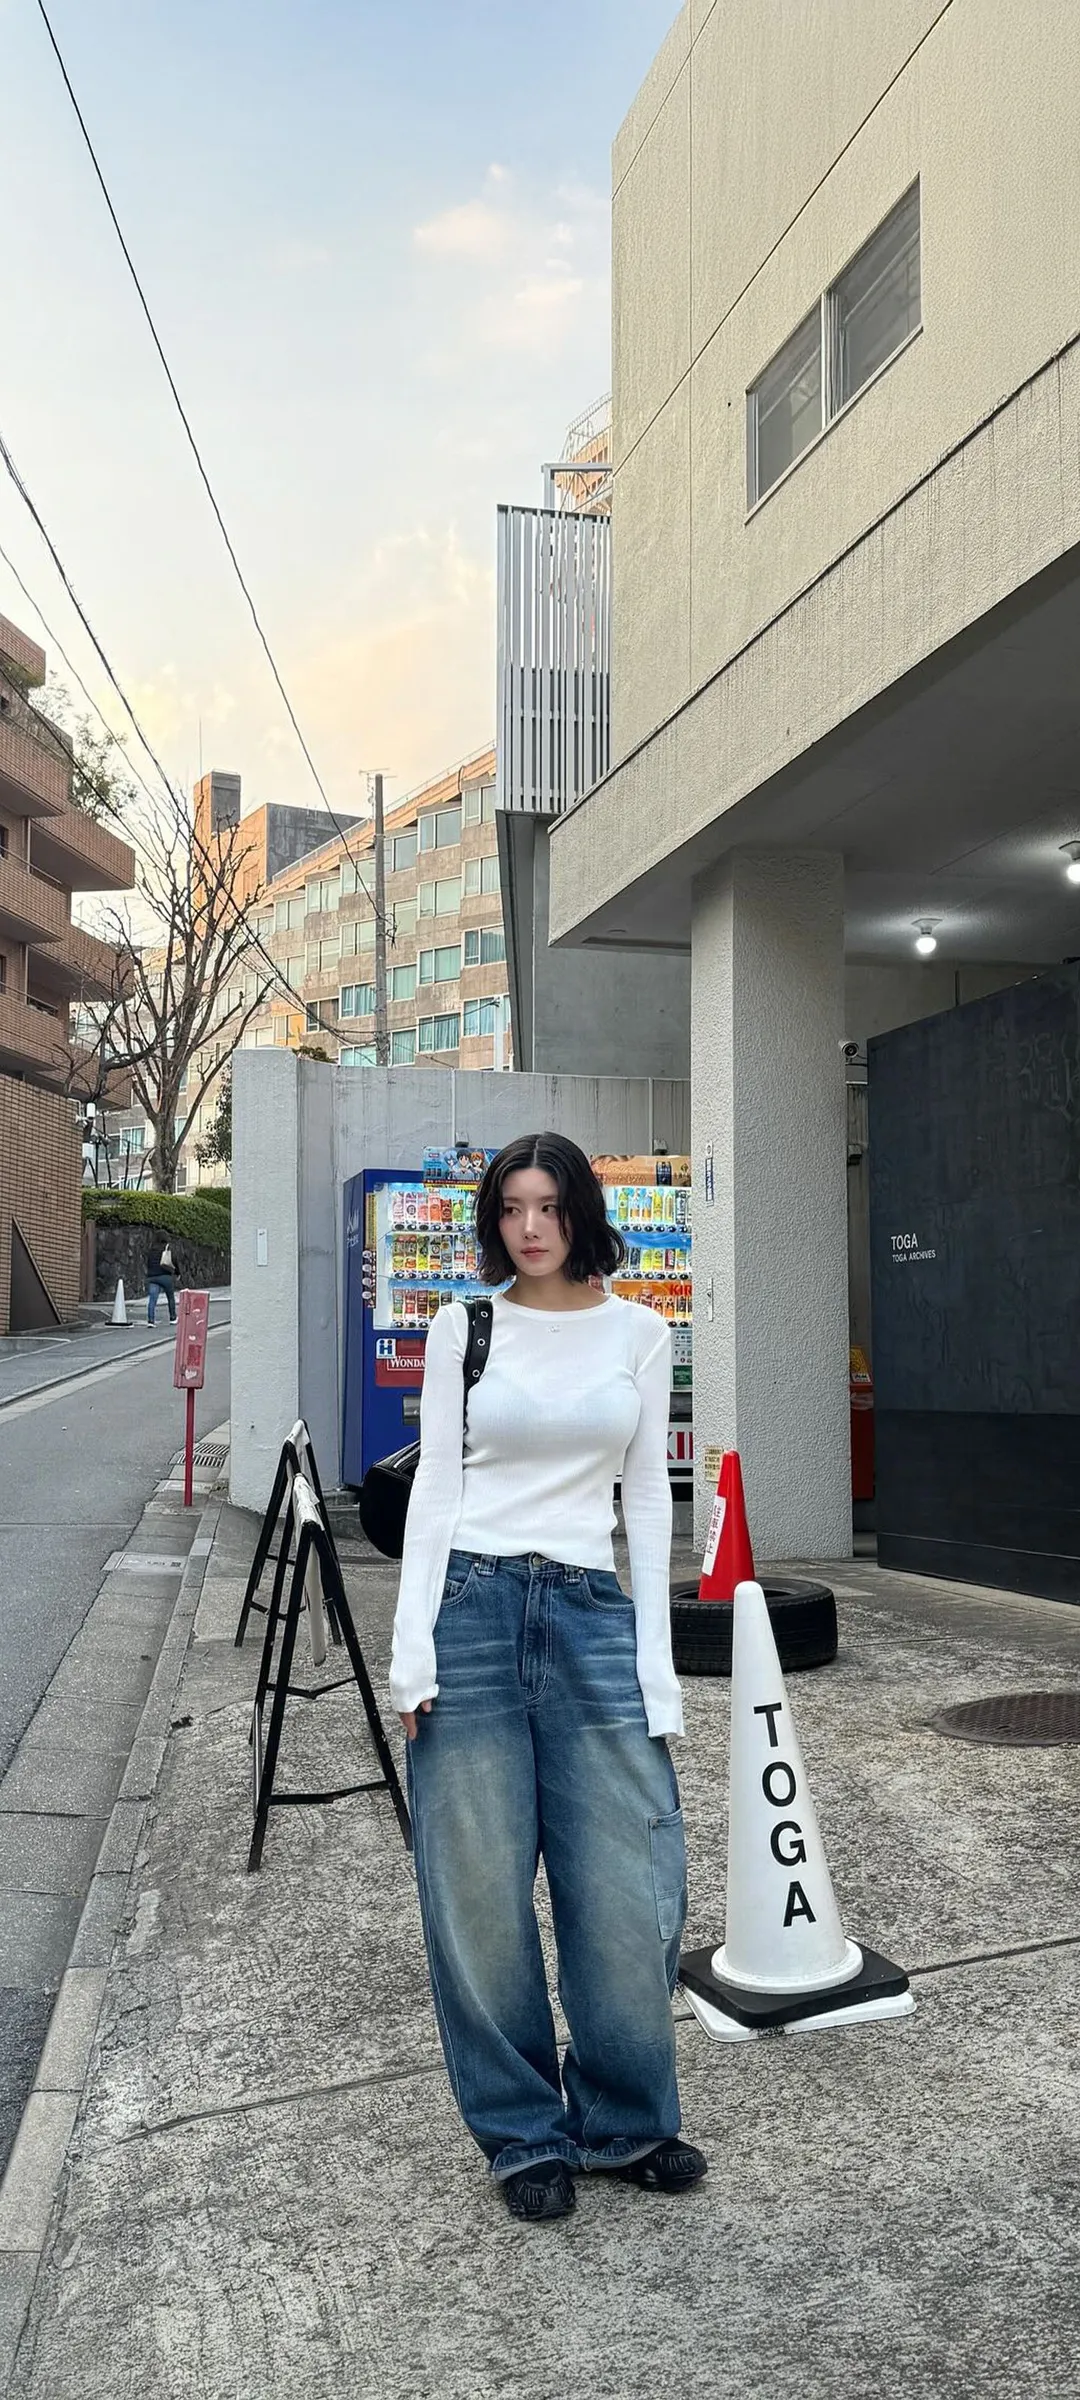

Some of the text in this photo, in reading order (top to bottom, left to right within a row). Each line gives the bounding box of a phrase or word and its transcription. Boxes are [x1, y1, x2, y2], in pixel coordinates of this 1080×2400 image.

[891, 1233, 918, 1250] TOGA
[892, 1250, 936, 1262] TOGA ARCHIVES
[753, 1702, 816, 1927] TOGA
